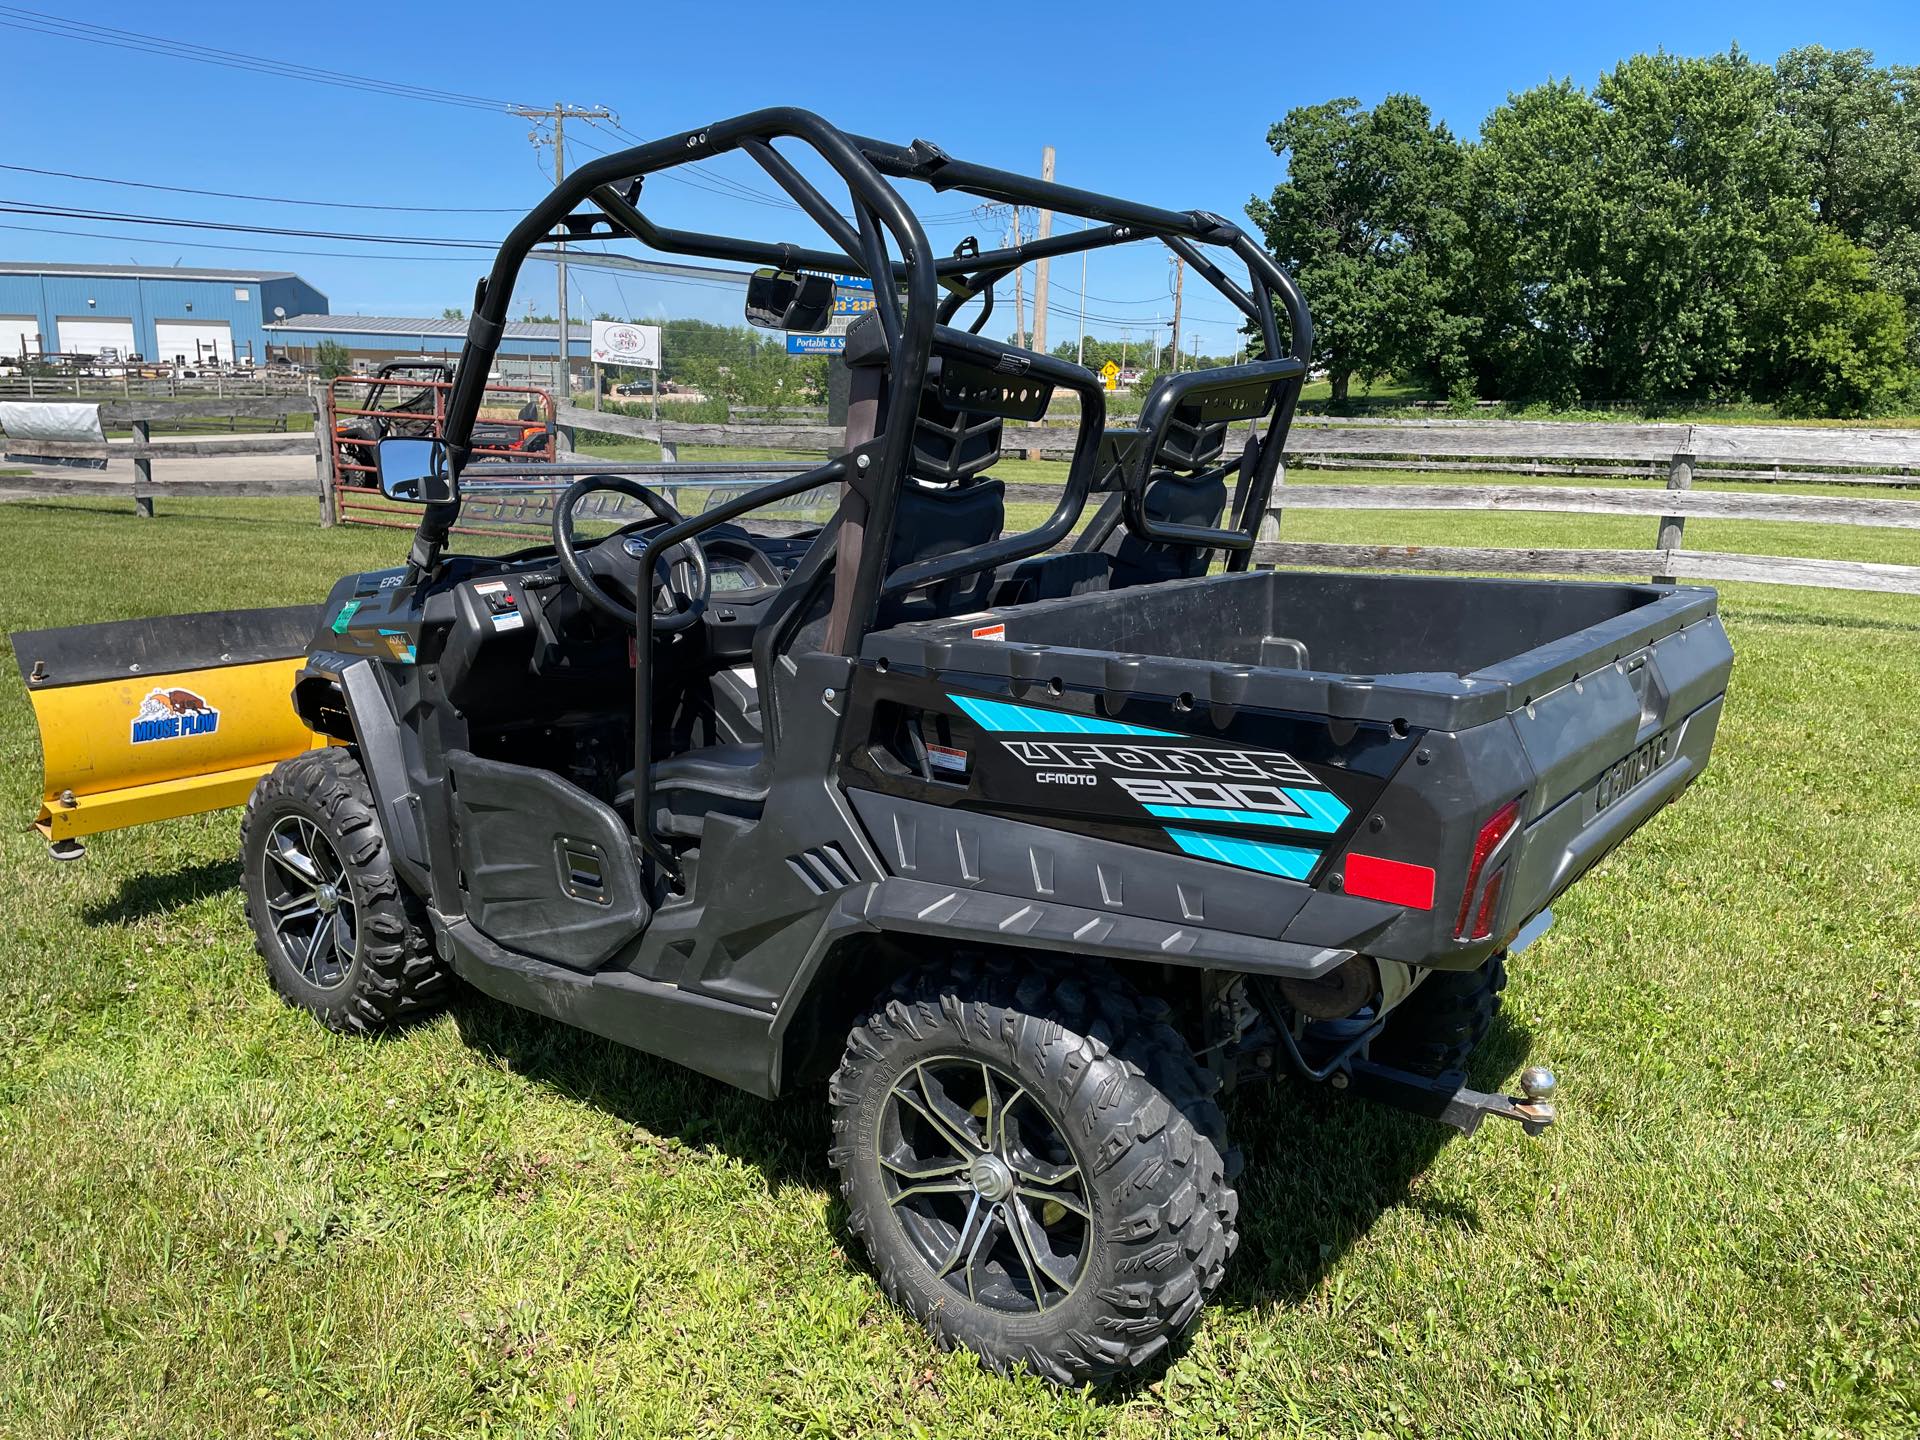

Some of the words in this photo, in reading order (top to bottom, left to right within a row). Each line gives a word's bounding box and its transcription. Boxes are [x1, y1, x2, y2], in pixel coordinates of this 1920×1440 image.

[796, 337, 828, 347] Portable
[829, 338, 836, 348] &
[379, 575, 405, 588] EPS
[132, 717, 180, 743] MOOSE
[180, 711, 219, 737] PLOW
[999, 740, 1322, 785] UFORCE
[1035, 772, 1098, 787] CFMOTO
[1111, 777, 1307, 815] 800
